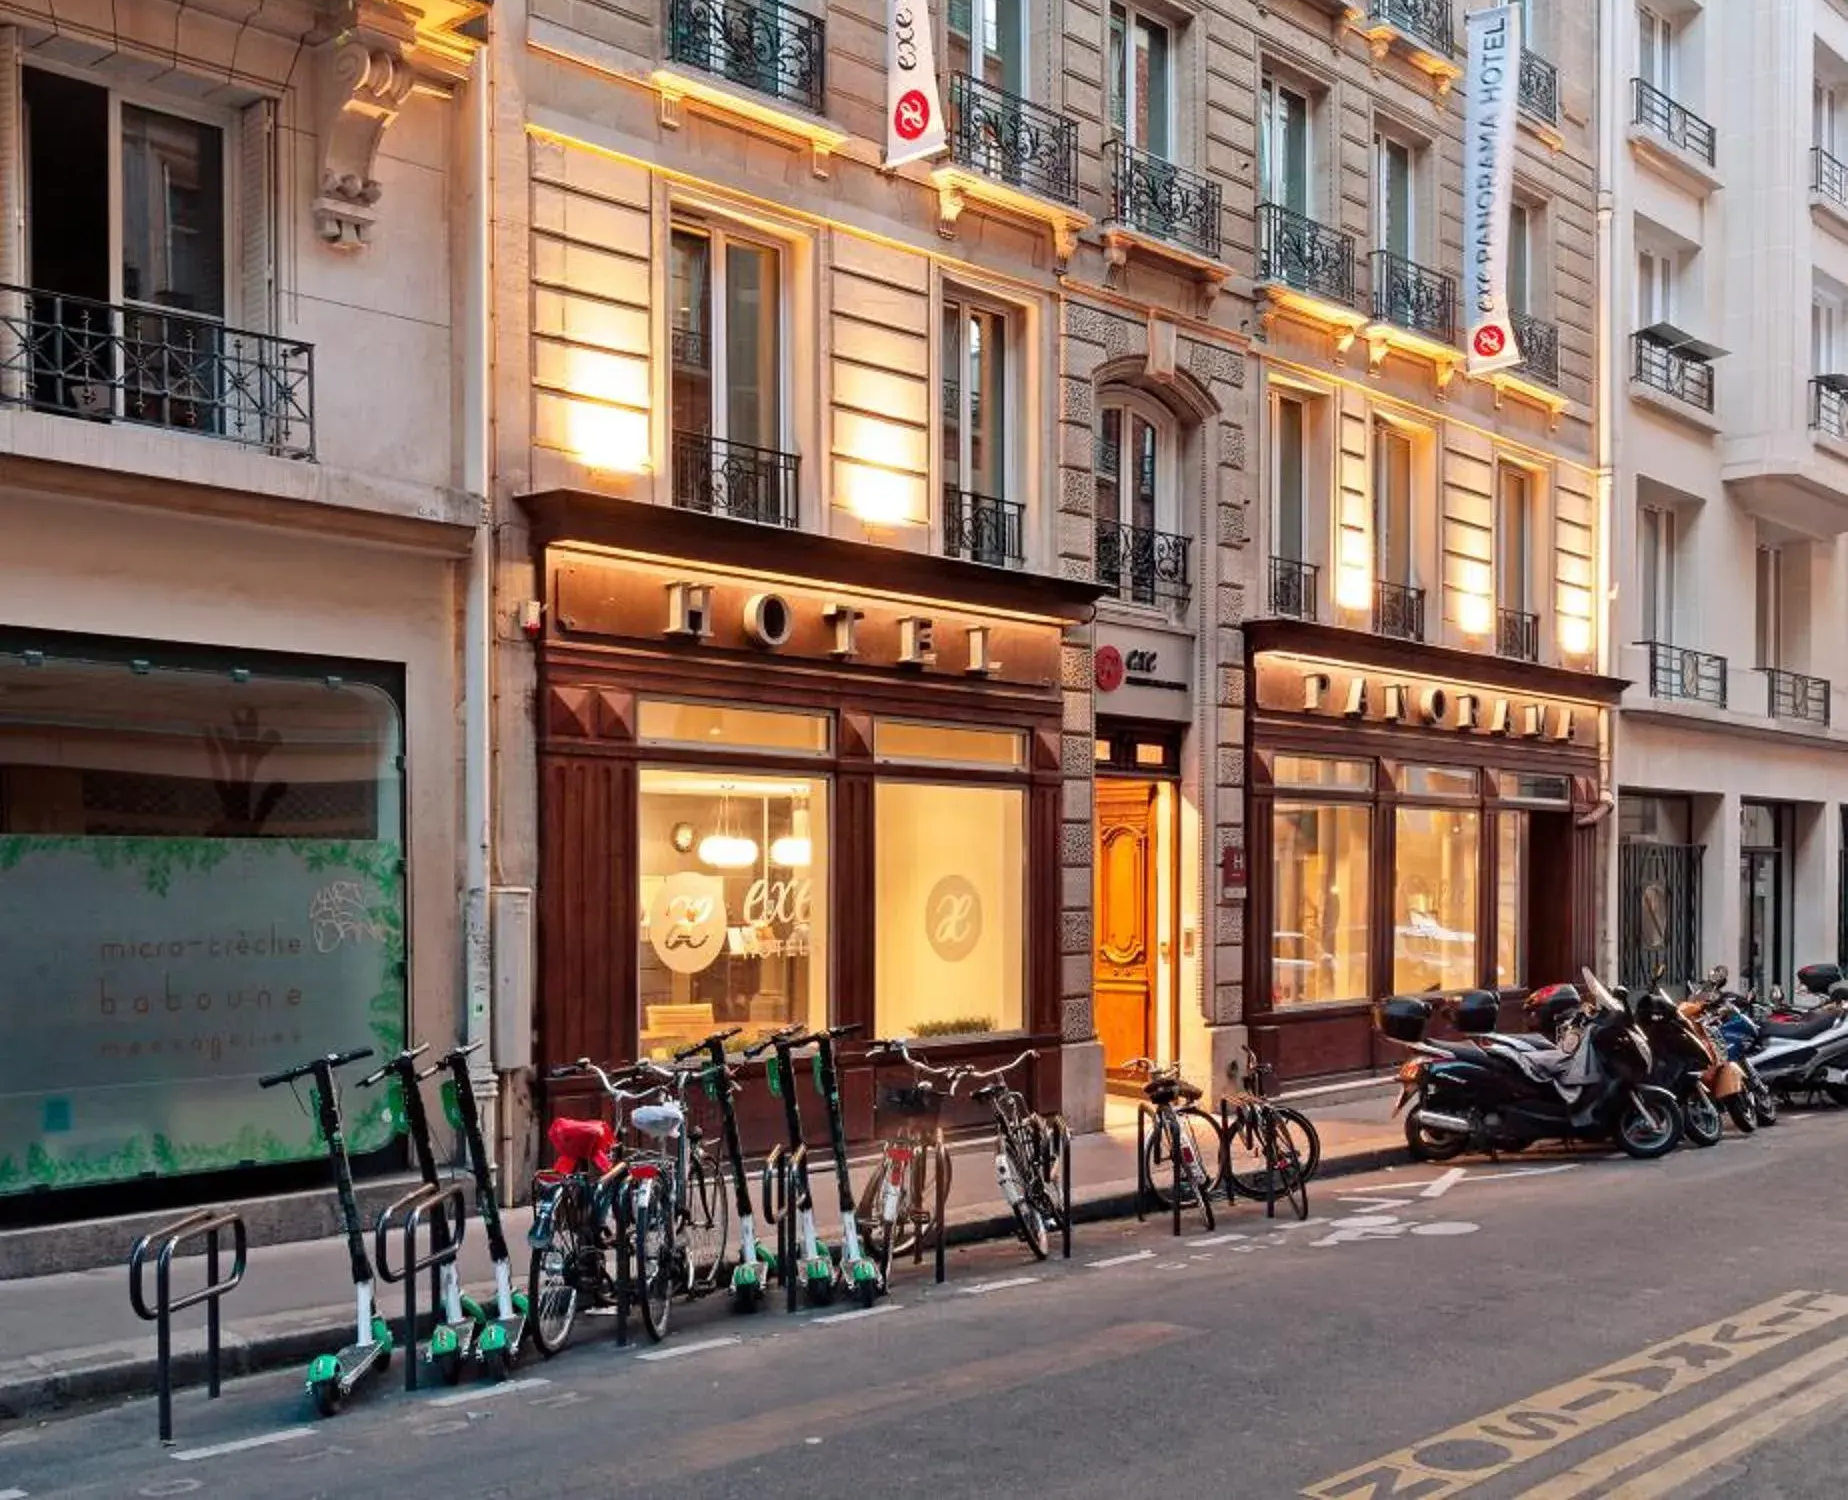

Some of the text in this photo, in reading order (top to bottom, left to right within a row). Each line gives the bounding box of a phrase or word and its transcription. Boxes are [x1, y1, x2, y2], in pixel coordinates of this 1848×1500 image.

[895, 7, 917, 71] exe
[1480, 17, 1506, 104] HOTEL
[1475, 113, 1499, 265] PANORAMA
[663, 580, 1004, 676] HOTEL
[1303, 673, 1575, 741] PANORAMA
